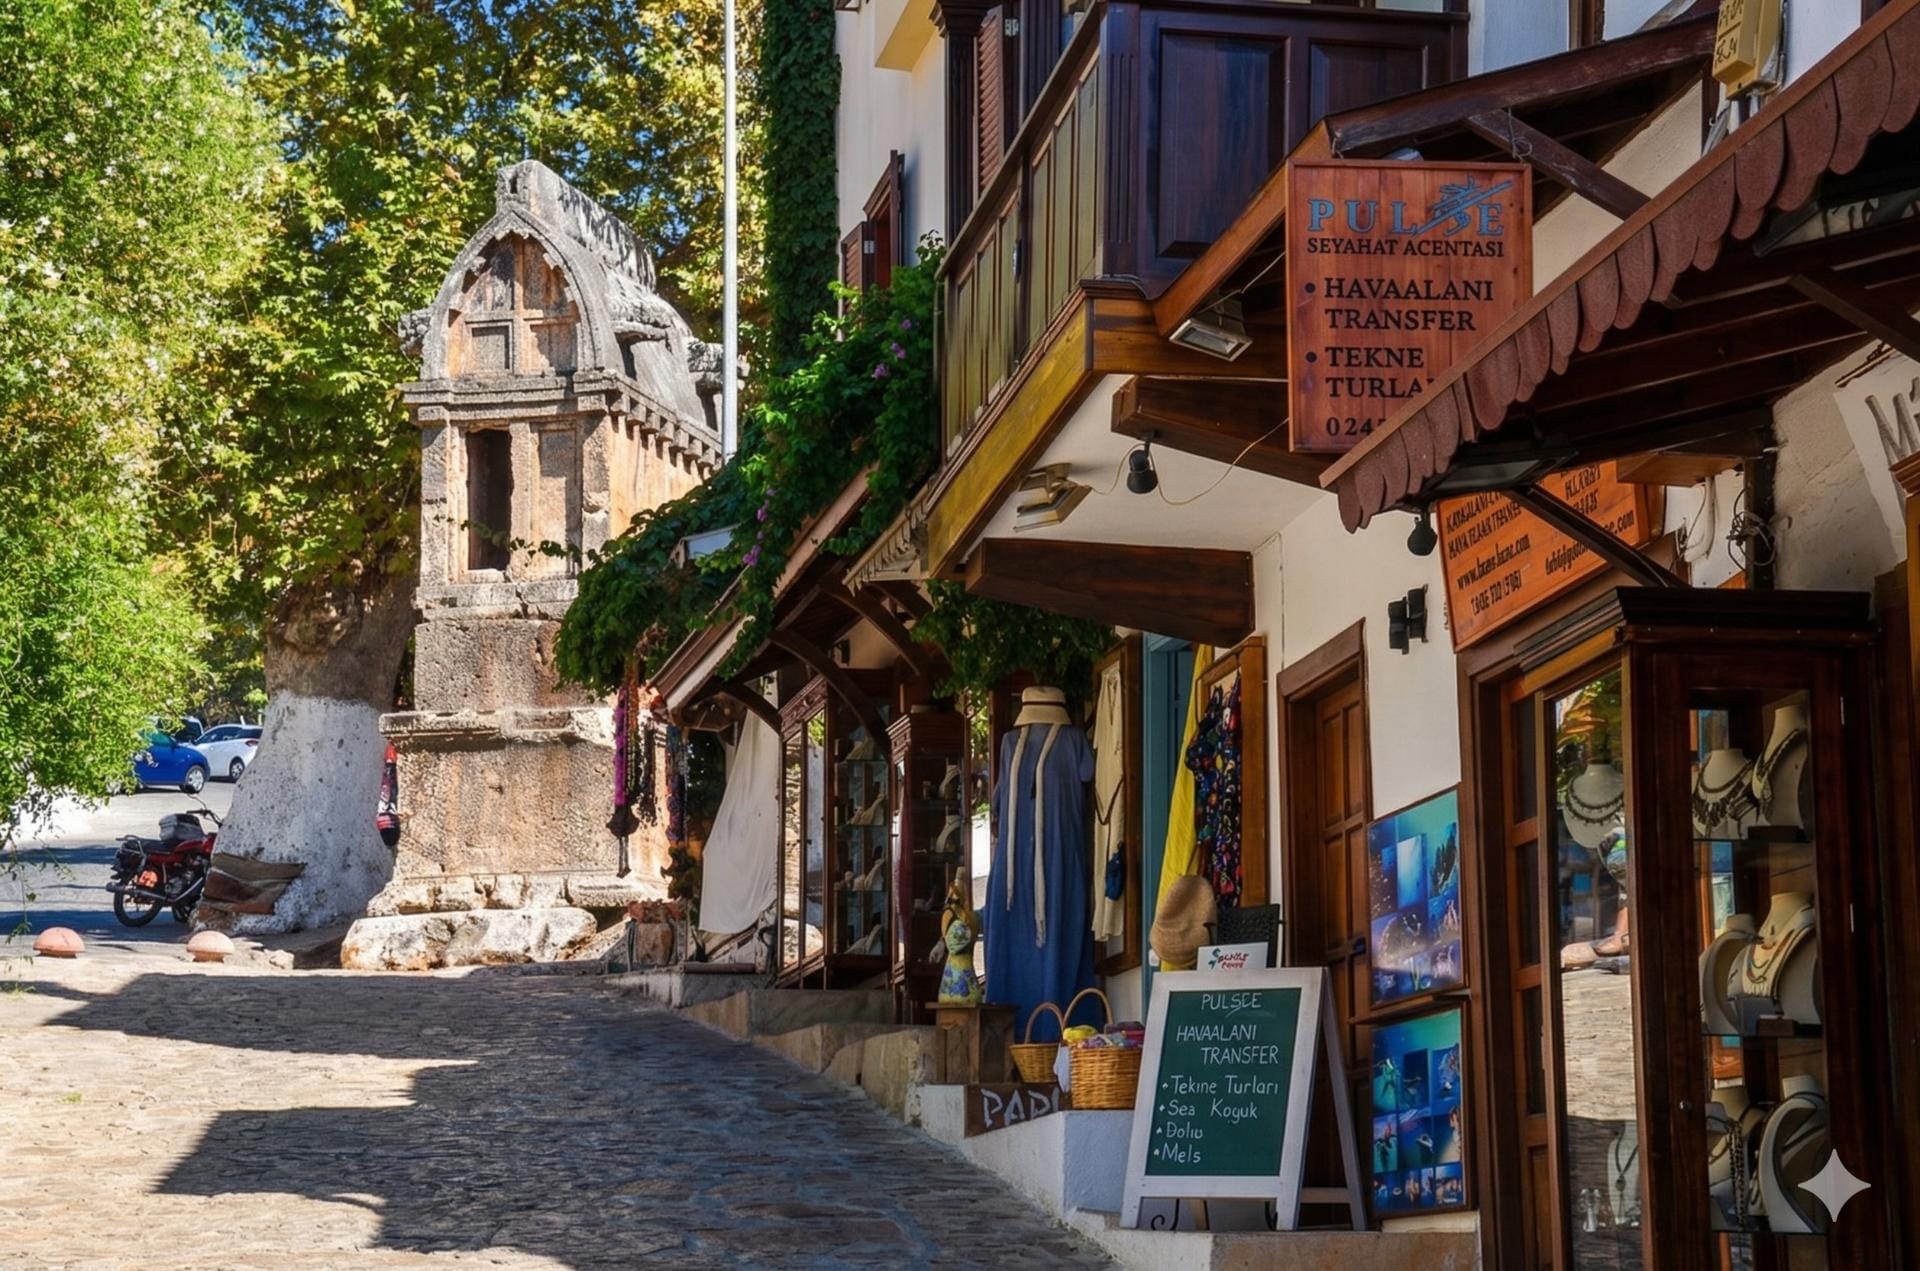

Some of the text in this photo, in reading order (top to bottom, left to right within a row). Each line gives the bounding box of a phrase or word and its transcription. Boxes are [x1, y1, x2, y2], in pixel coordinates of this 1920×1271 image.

[1307, 238, 1504, 257] SEYAHAT ACENTASI
[1324, 277, 1494, 301] HAVAALANI
[1324, 308, 1476, 331] TRANSFER
[1324, 346, 1424, 368] TEKNE
[1325, 377, 1435, 398] TURLA
[1326, 416, 1386, 436] 024
[1176, 1024, 1257, 1042] HAVAALANI
[1200, 1044, 1279, 1065] TRANSFER
[1167, 1099, 1196, 1116] Sea
